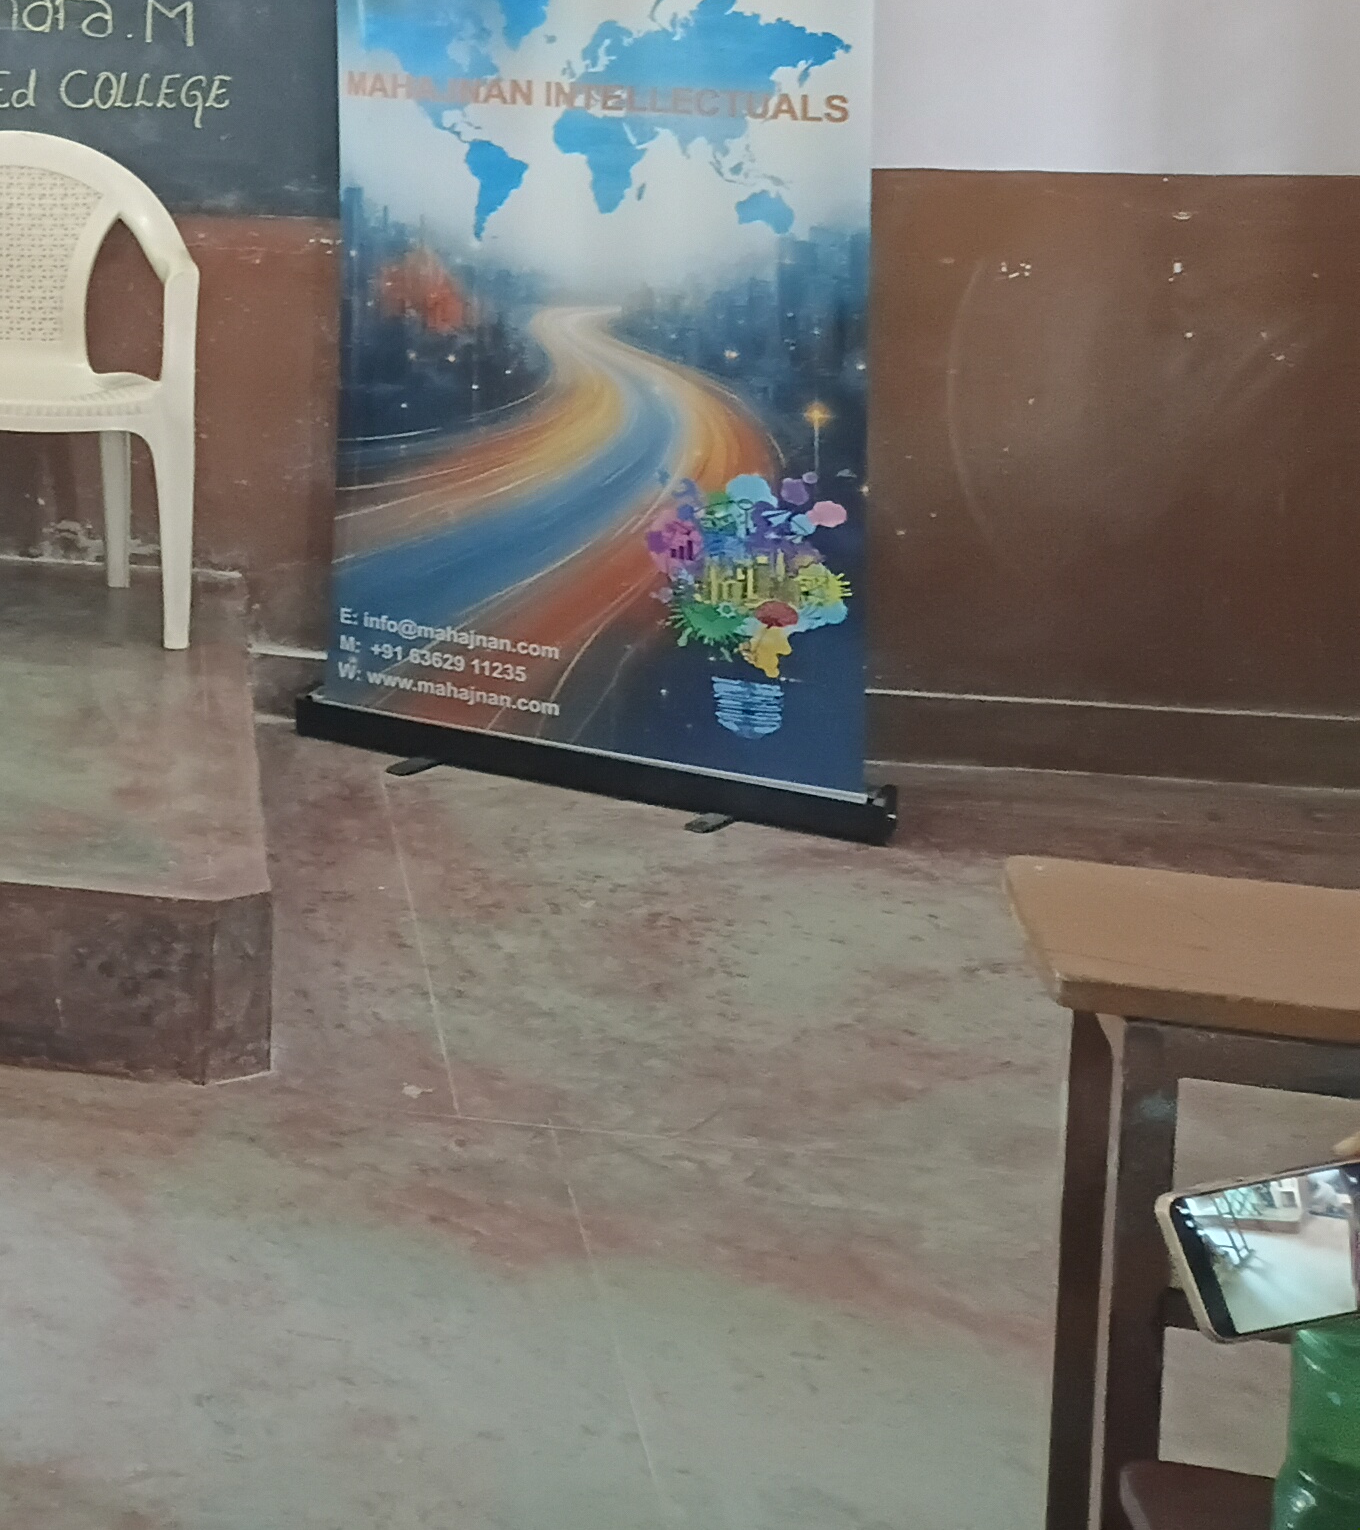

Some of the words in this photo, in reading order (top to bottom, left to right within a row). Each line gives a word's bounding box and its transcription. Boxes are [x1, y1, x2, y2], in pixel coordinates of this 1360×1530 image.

[60, 70, 232, 128] COLLEGE
[545, 80, 850, 124] INTELLECTUALS
[340, 607, 359, 626] E:
[363, 611, 560, 660] info@mahajnan.com
[340, 634, 361, 654] M:
[370, 643, 403, 661] +91
[471, 657, 528, 682] 11235
[367, 669, 561, 717] www.mahajnan.com
